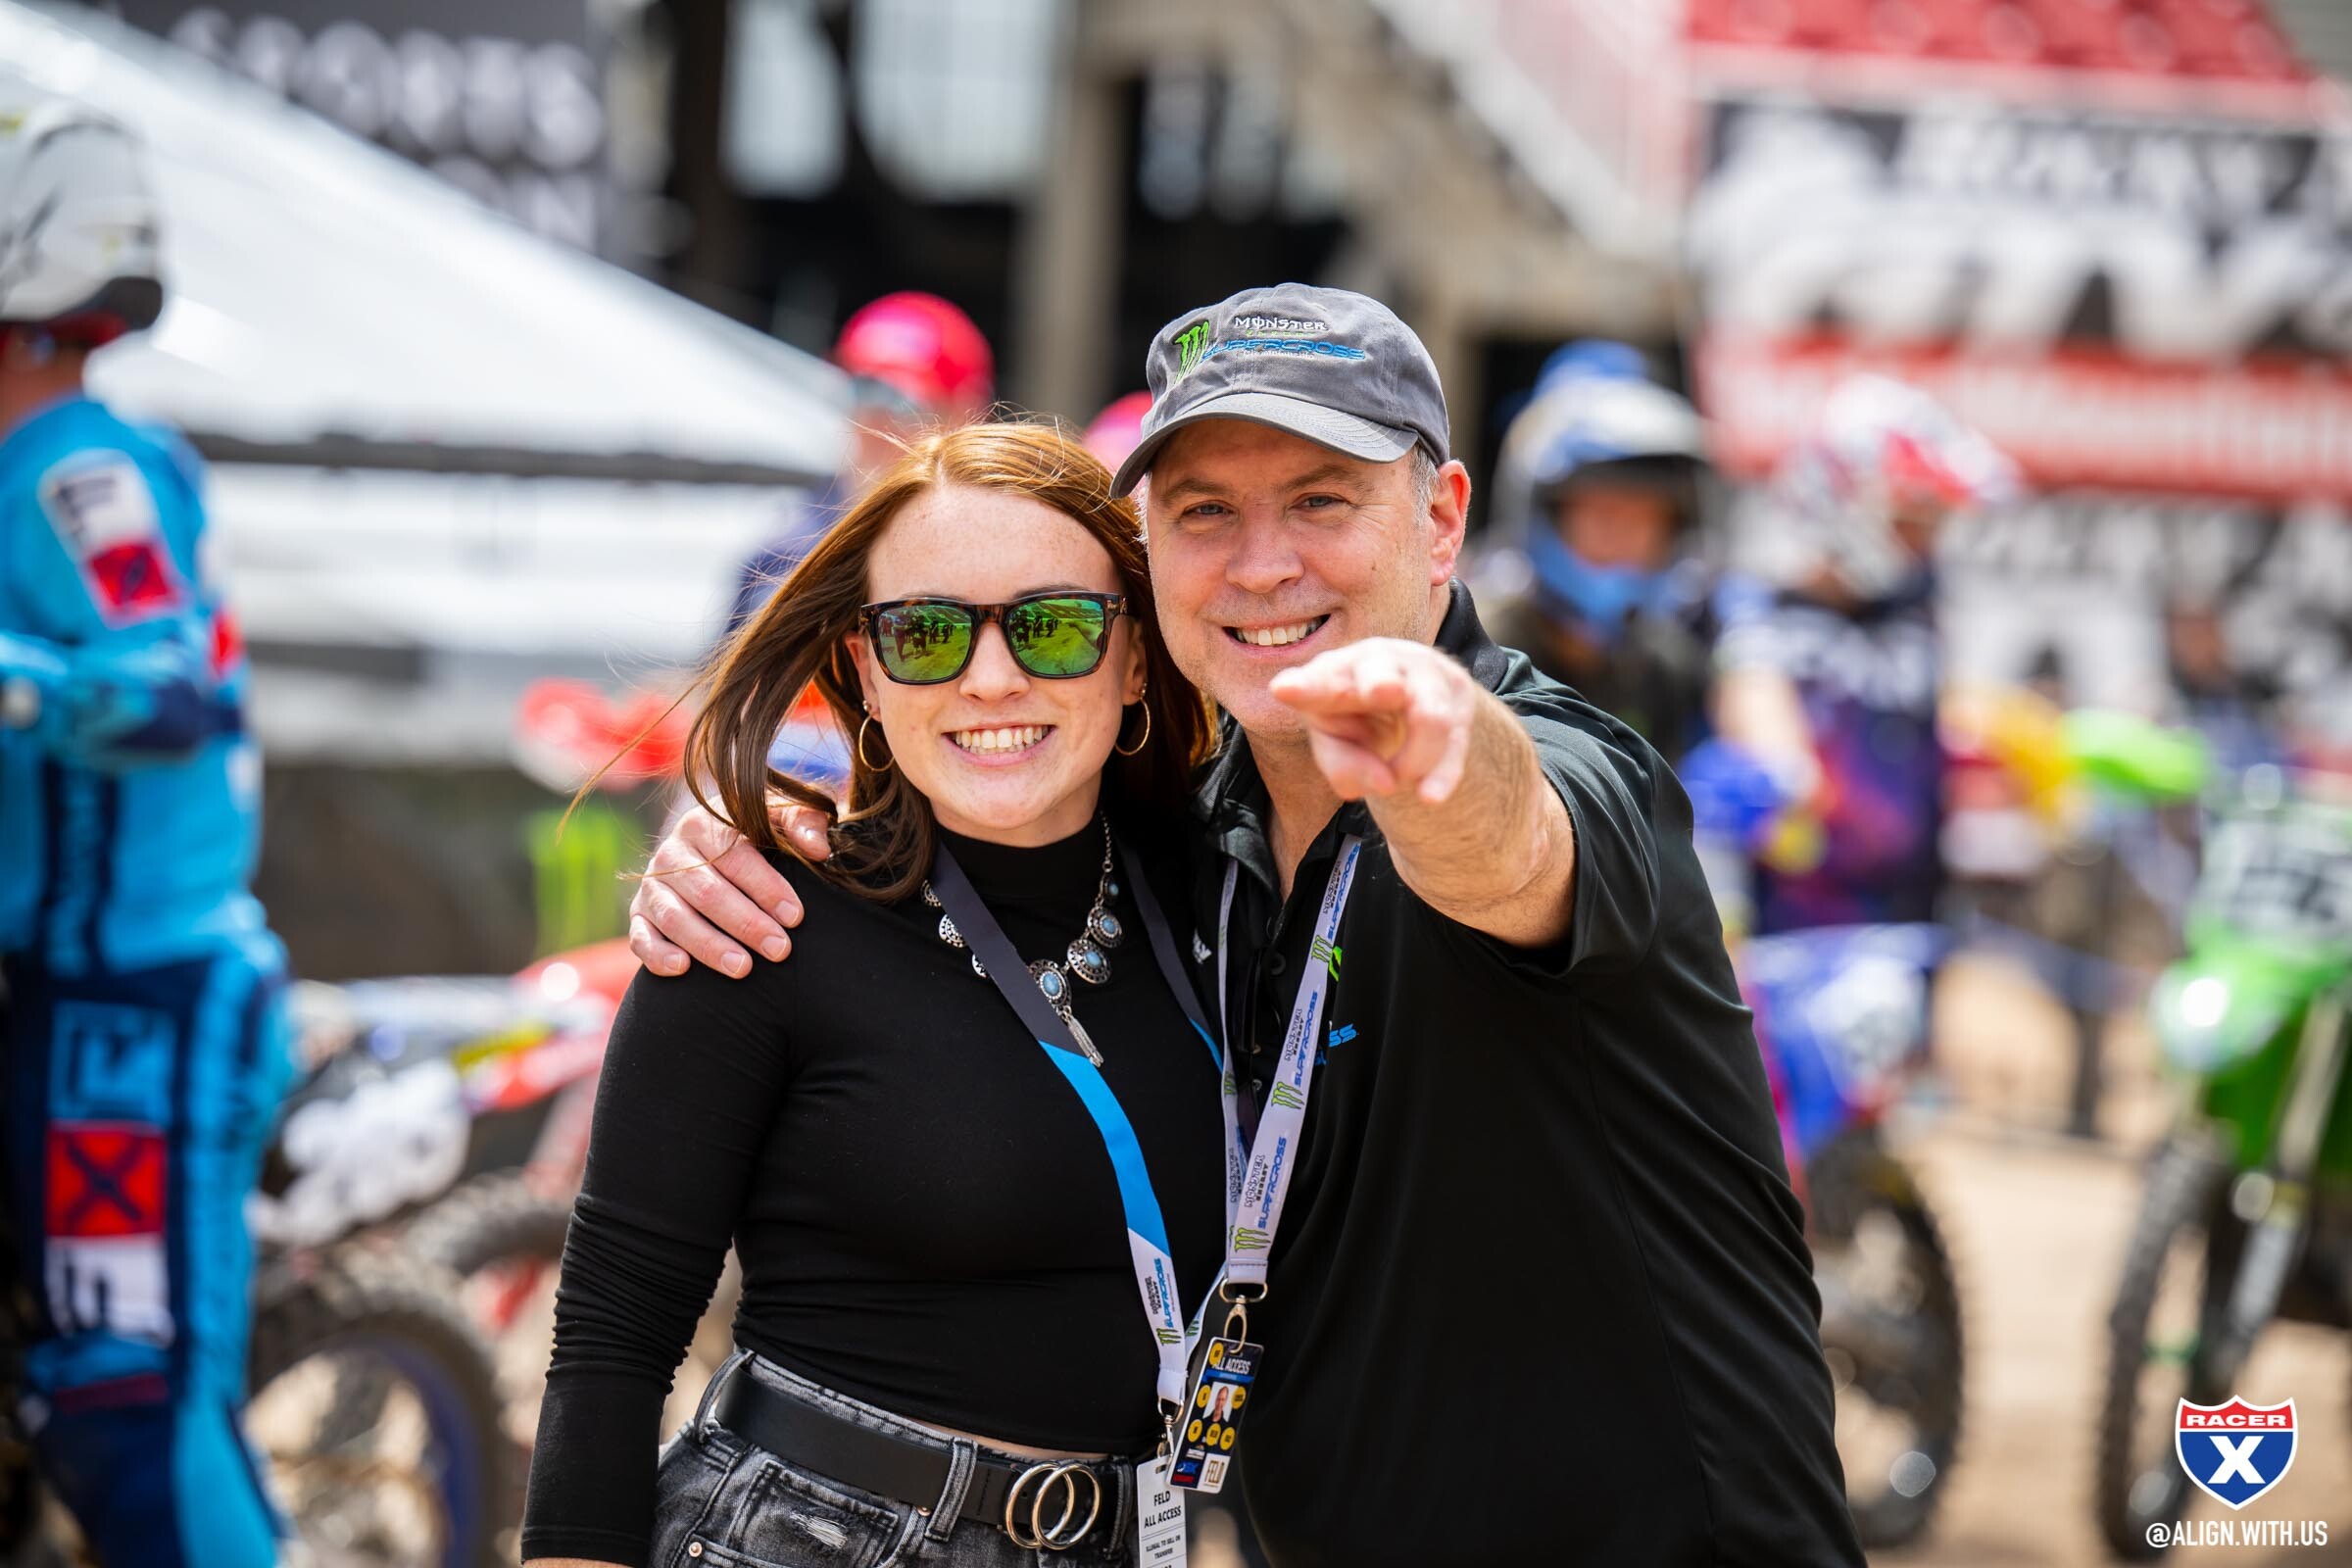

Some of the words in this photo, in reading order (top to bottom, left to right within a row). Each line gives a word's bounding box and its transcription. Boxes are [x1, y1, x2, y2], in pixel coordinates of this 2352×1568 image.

[1234, 317, 1328, 330] MONSTER
[1200, 339, 1366, 364] SUPERCROSS
[1328, 844, 1360, 941] SUPERCROSS
[1295, 991, 1318, 1087] SUPERCROSS
[1245, 1153, 1265, 1207] MONSTER
[1257, 1136, 1287, 1229] SUPERCROSS
[1225, 1358, 1251, 1375] ACCESS
[1153, 1491, 1171, 1506] FELD
[1144, 1515, 1156, 1529] ALL
[1157, 1505, 1182, 1524] ACCESS
